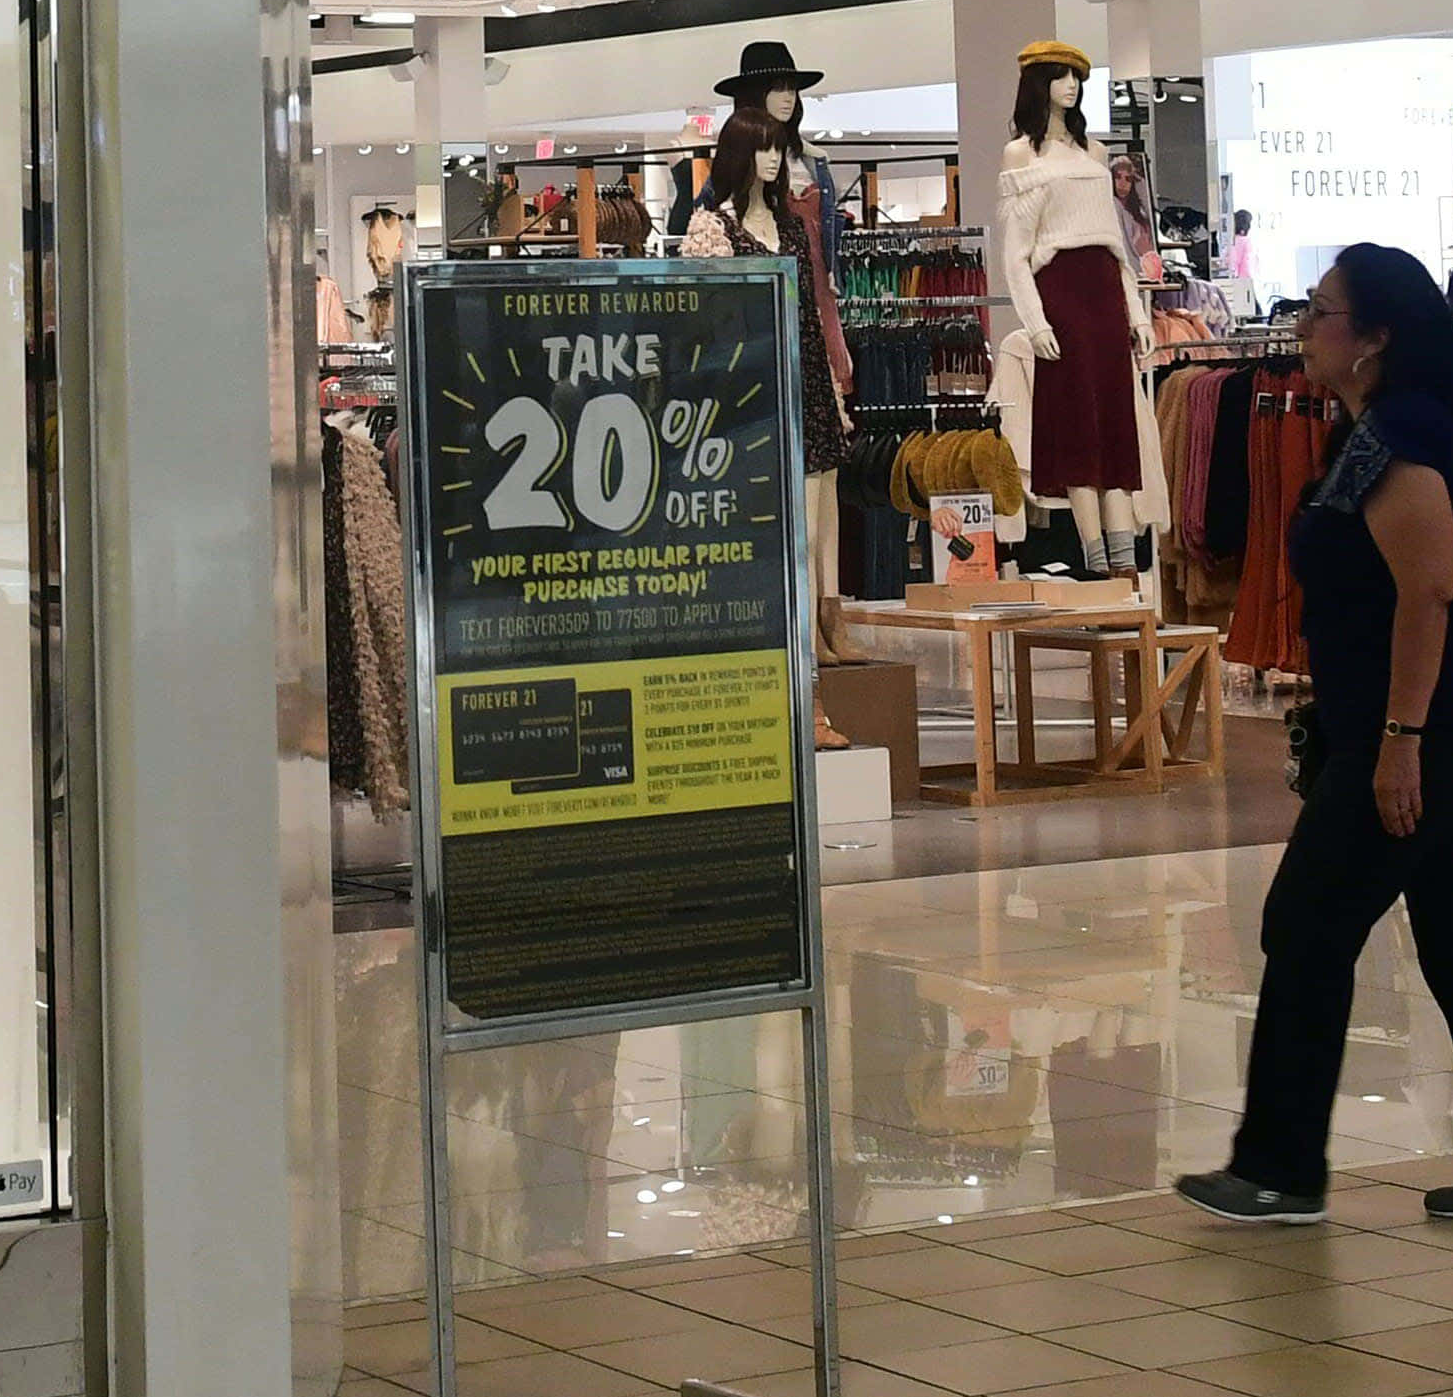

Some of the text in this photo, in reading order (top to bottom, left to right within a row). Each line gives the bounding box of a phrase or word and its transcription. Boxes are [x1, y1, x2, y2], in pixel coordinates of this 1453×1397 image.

[1253, 131, 1332, 153] EVER 21
[1291, 170, 1420, 196] FOREVER 21
[504, 291, 699, 317] FOREVER REWARDED
[542, 333, 662, 387] TAKE
[665, 489, 737, 528] OFF
[472, 541, 753, 584] YOUR FIRST REGULAR PRICE
[523, 575, 630, 604] PURCHASE
[460, 618, 495, 641] TEXT
[499, 612, 590, 640] FOREVER3509
[597, 610, 612, 630] TO
[663, 606, 678, 627] TO
[683, 604, 721, 625] APPLY
[727, 600, 766, 621] TODAY
[462, 689, 537, 711] FOREVER 21
[580, 700, 593, 716] 21
[603, 765, 628, 779] VISA
[9, 1173, 36, 1193] Pay
